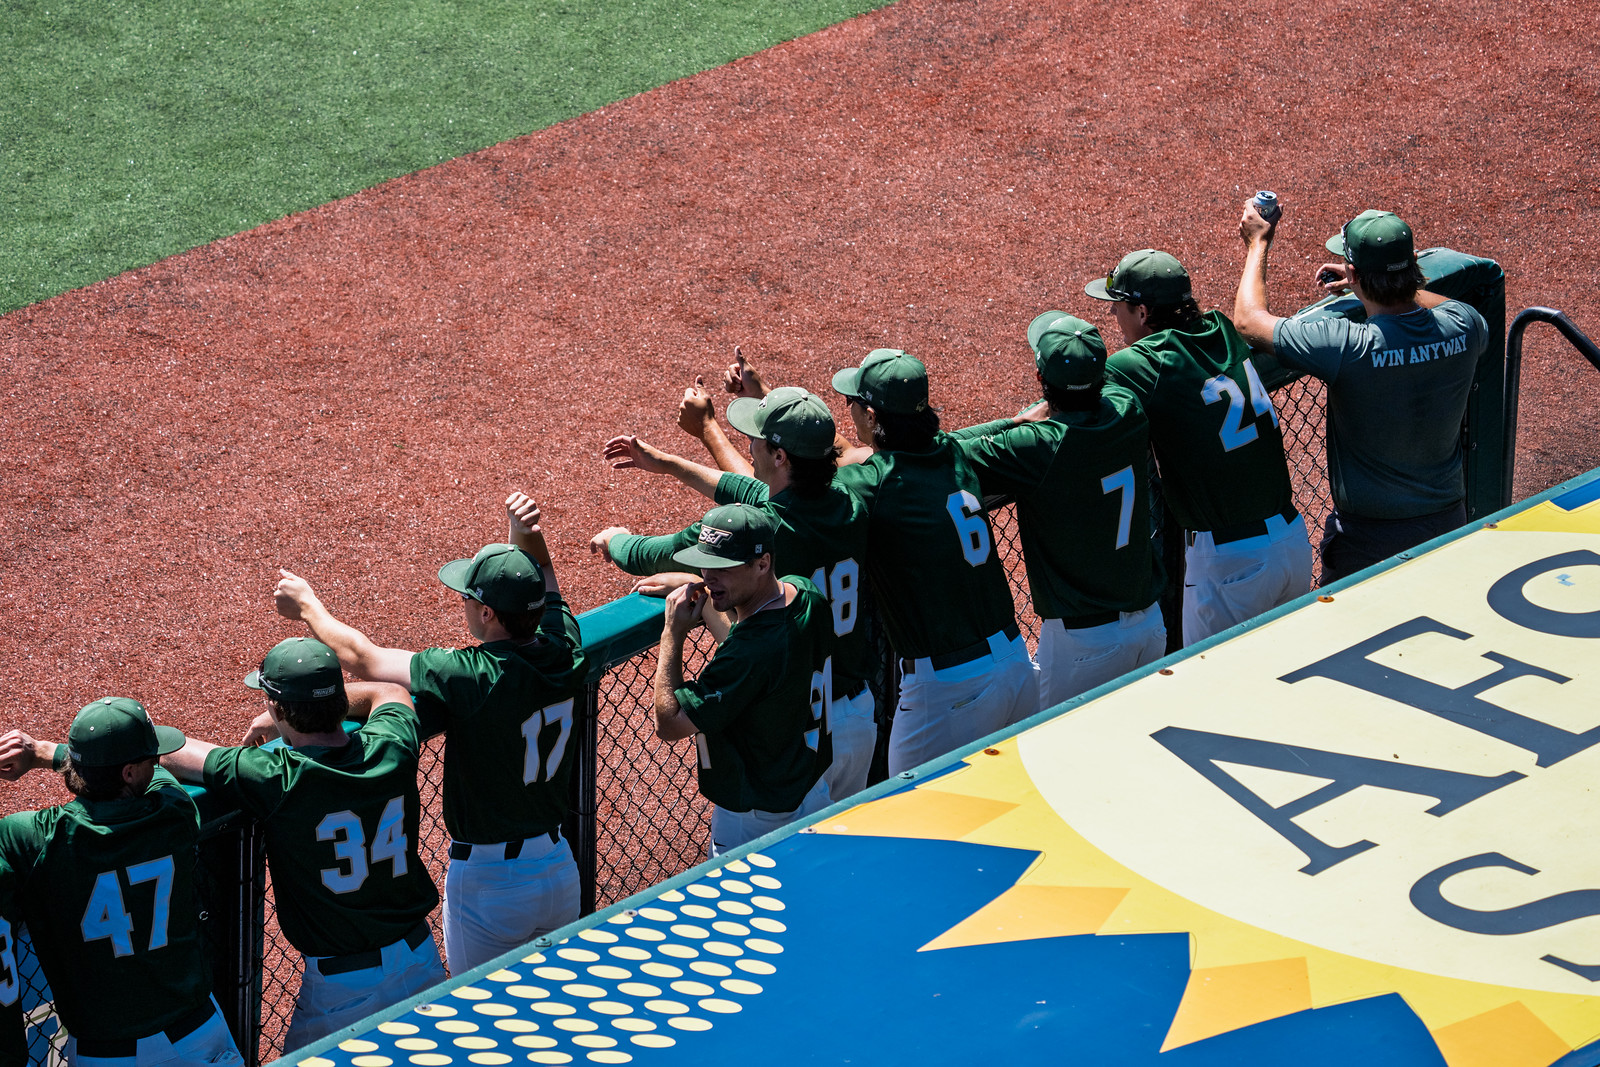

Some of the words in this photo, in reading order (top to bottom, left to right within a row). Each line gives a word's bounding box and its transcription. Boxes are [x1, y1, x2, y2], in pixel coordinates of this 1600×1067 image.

[1371, 349, 1405, 368] WIN
[1409, 334, 1468, 364] ANYWAY
[1200, 357, 1279, 452] 24
[698, 524, 733, 546] S&T
[945, 490, 990, 567] 6
[1101, 466, 1136, 550] 7
[521, 699, 574, 786] 17
[316, 796, 407, 894] 34
[81, 856, 175, 957] 47
